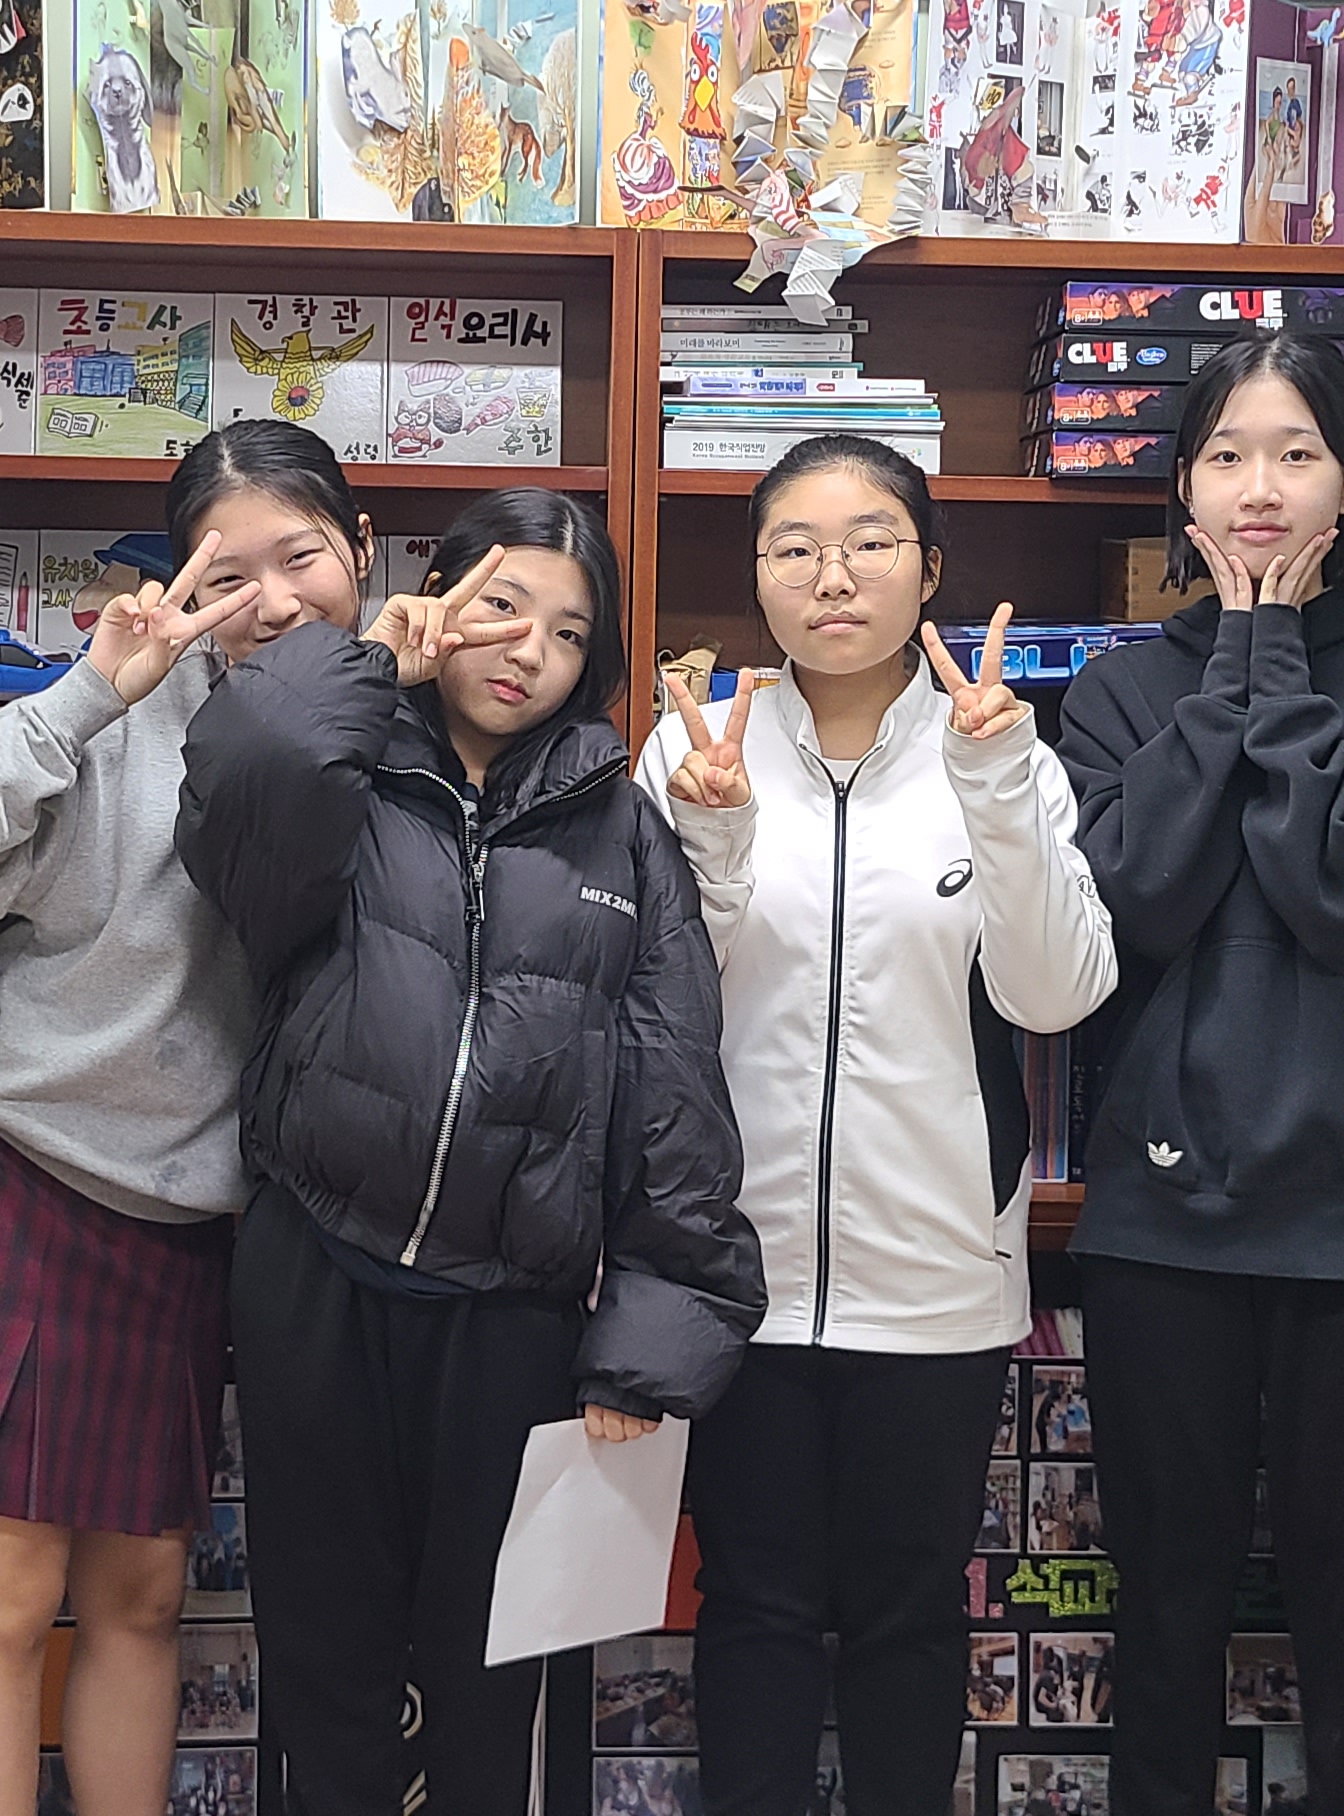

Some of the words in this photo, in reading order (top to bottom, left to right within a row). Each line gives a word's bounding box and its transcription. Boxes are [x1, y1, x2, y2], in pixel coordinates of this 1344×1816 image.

[247, 297, 362, 334] 경찰관
[1198, 289, 1284, 321] CLUE
[405, 298, 456, 344] 일식
[457, 308, 552, 347] 요리사
[1067, 341, 1128, 365] CLUE
[692, 442, 714, 452] 2019
[42, 554, 99, 582] 유치원
[580, 886, 638, 923] MIX2MI
